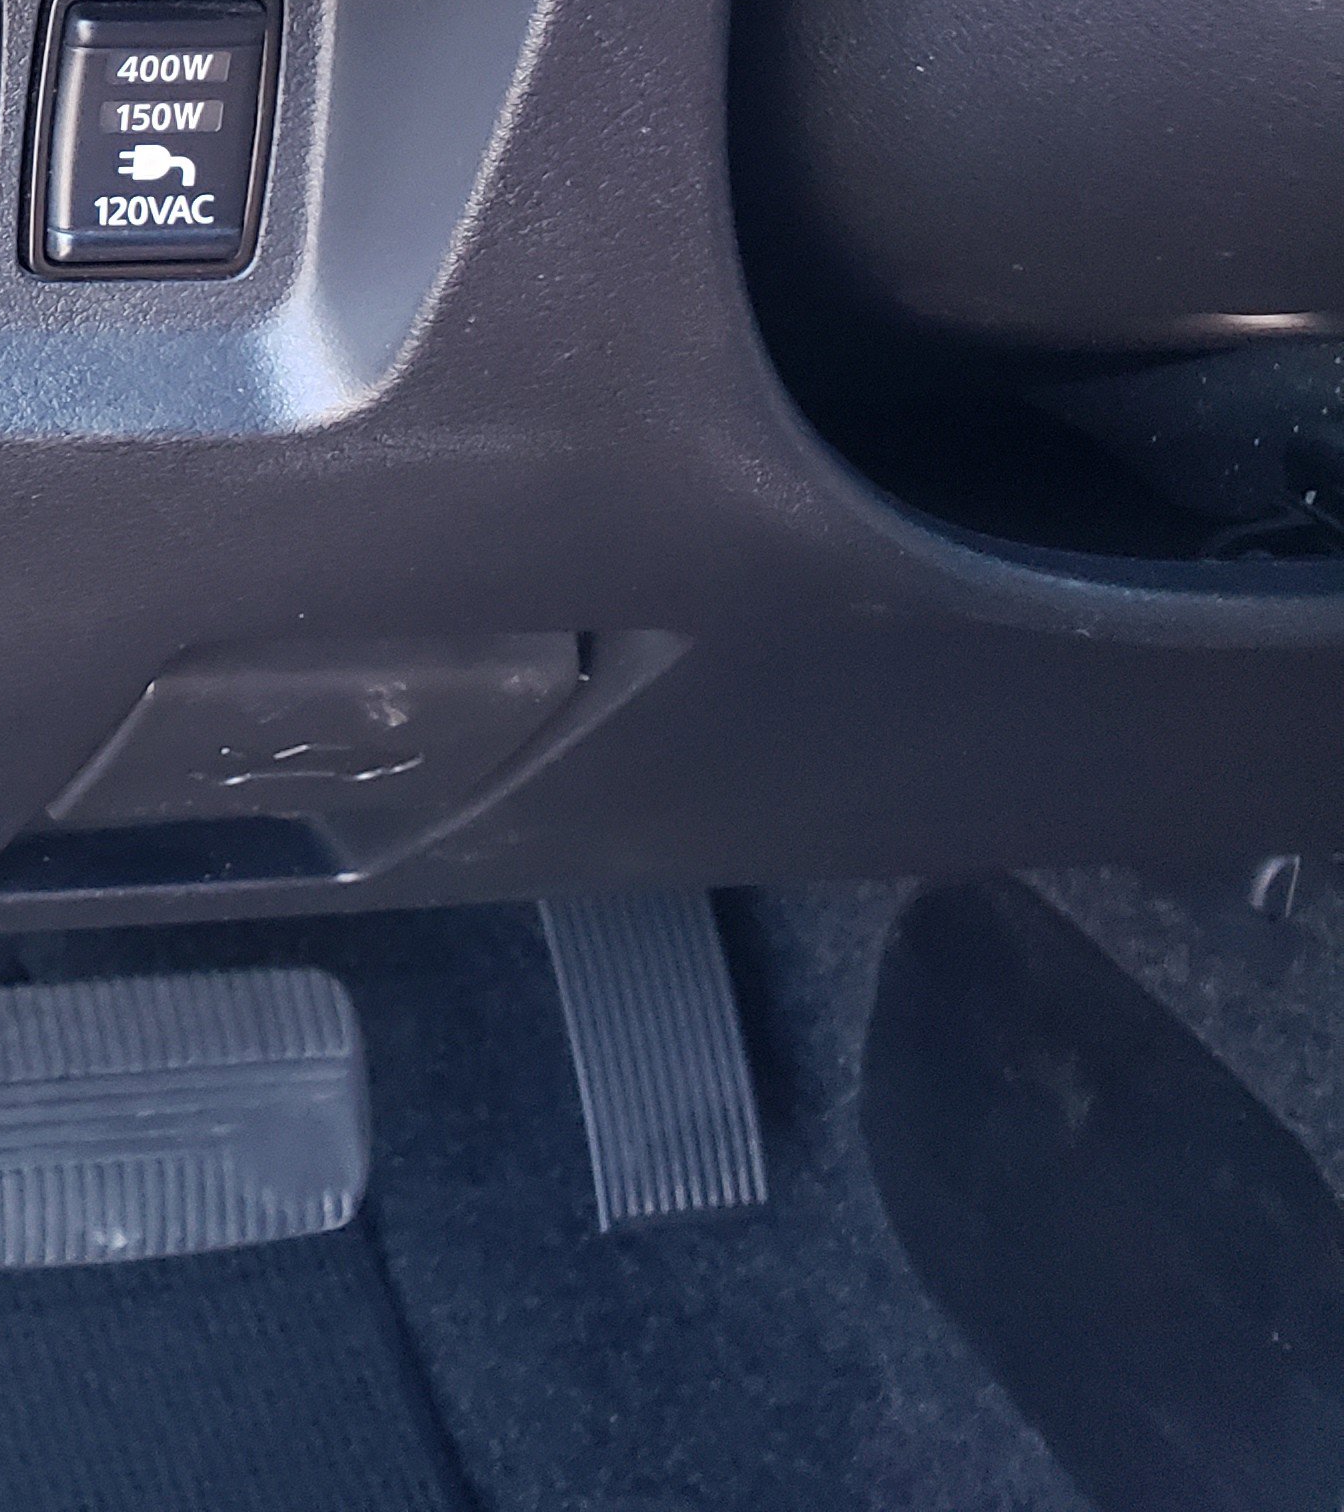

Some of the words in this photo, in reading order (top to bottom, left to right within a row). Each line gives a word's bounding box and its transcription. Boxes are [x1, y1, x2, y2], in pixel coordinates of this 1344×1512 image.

[116, 53, 214, 83] 400W
[116, 102, 205, 131] 150W
[94, 194, 215, 226] 120VAC
